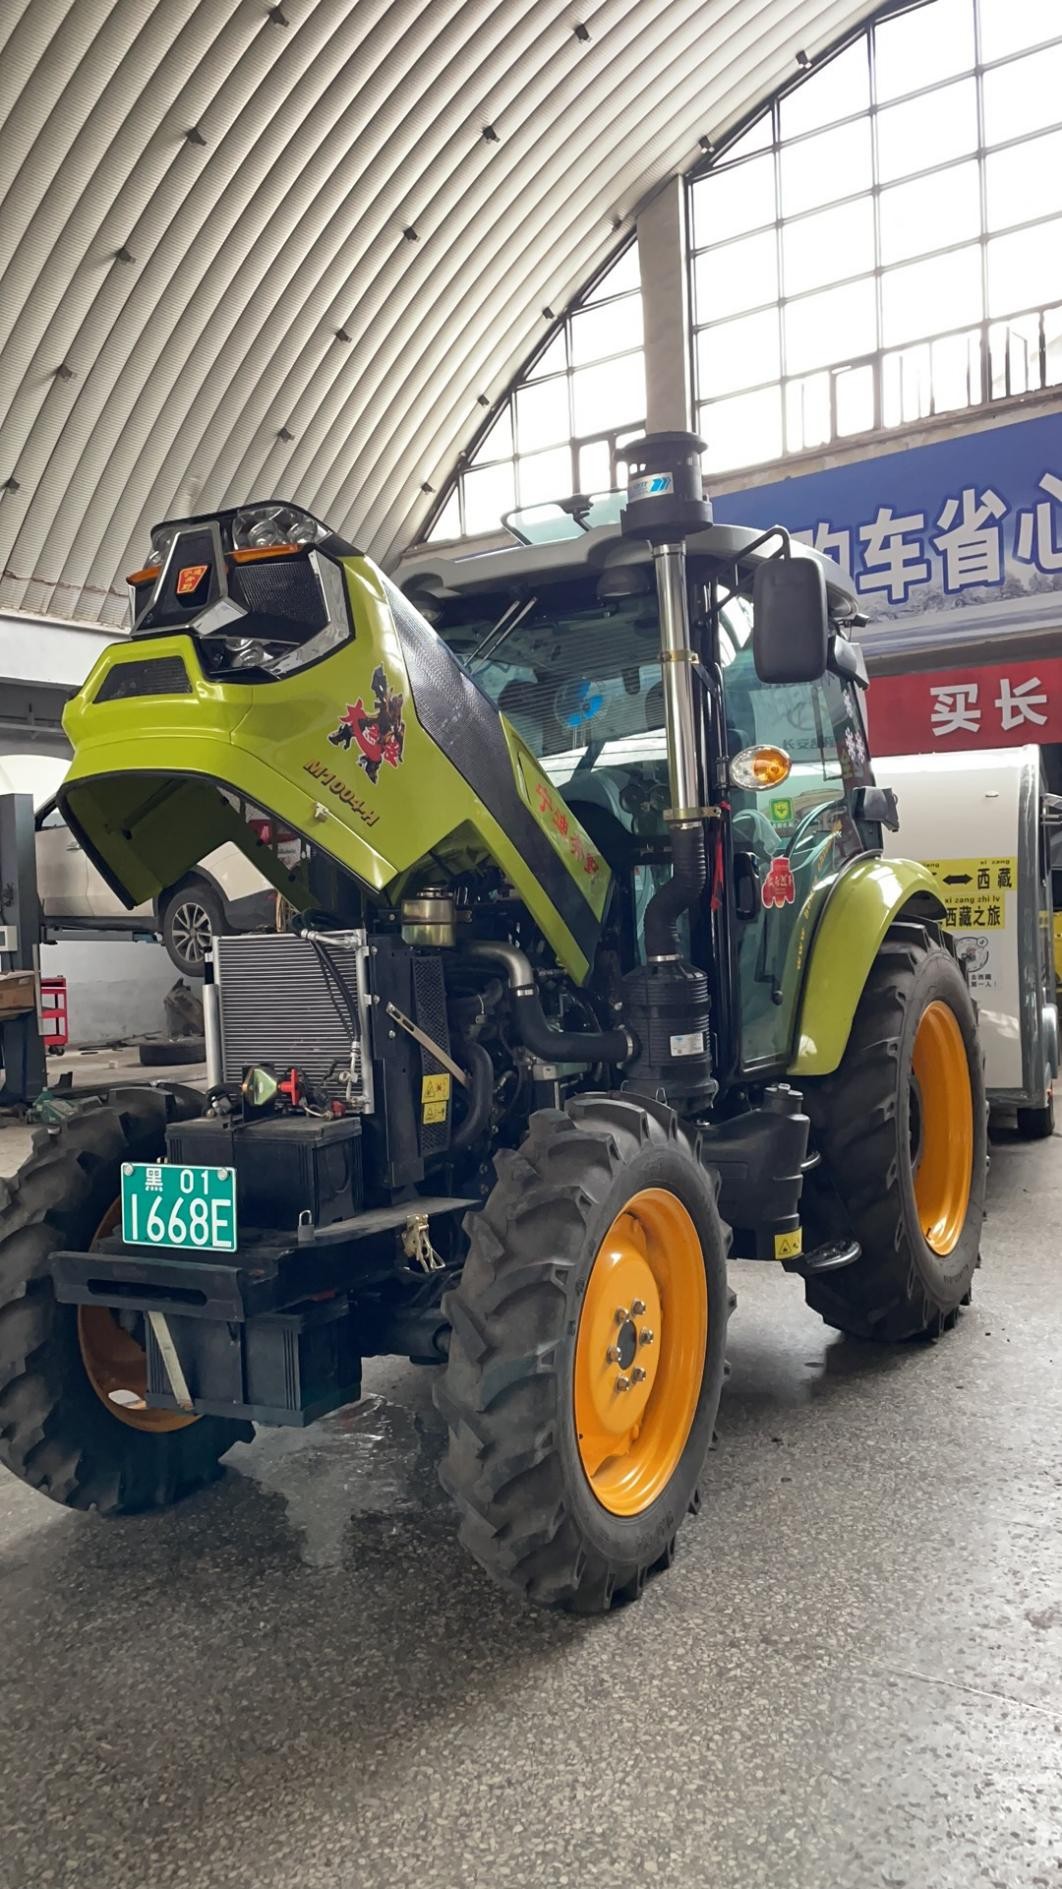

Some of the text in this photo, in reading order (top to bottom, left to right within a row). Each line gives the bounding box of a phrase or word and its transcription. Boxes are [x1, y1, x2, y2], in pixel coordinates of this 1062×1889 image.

[930, 677, 1048, 736] 买长
[303, 760, 380, 827] M1004-H
[977, 867, 1012, 890] 西藏
[955, 896, 975, 904] zang
[940, 904, 1001, 927] 西藏之旅
[145, 1167, 209, 1195] 黑 01
[131, 1194, 232, 1248] 1668E
